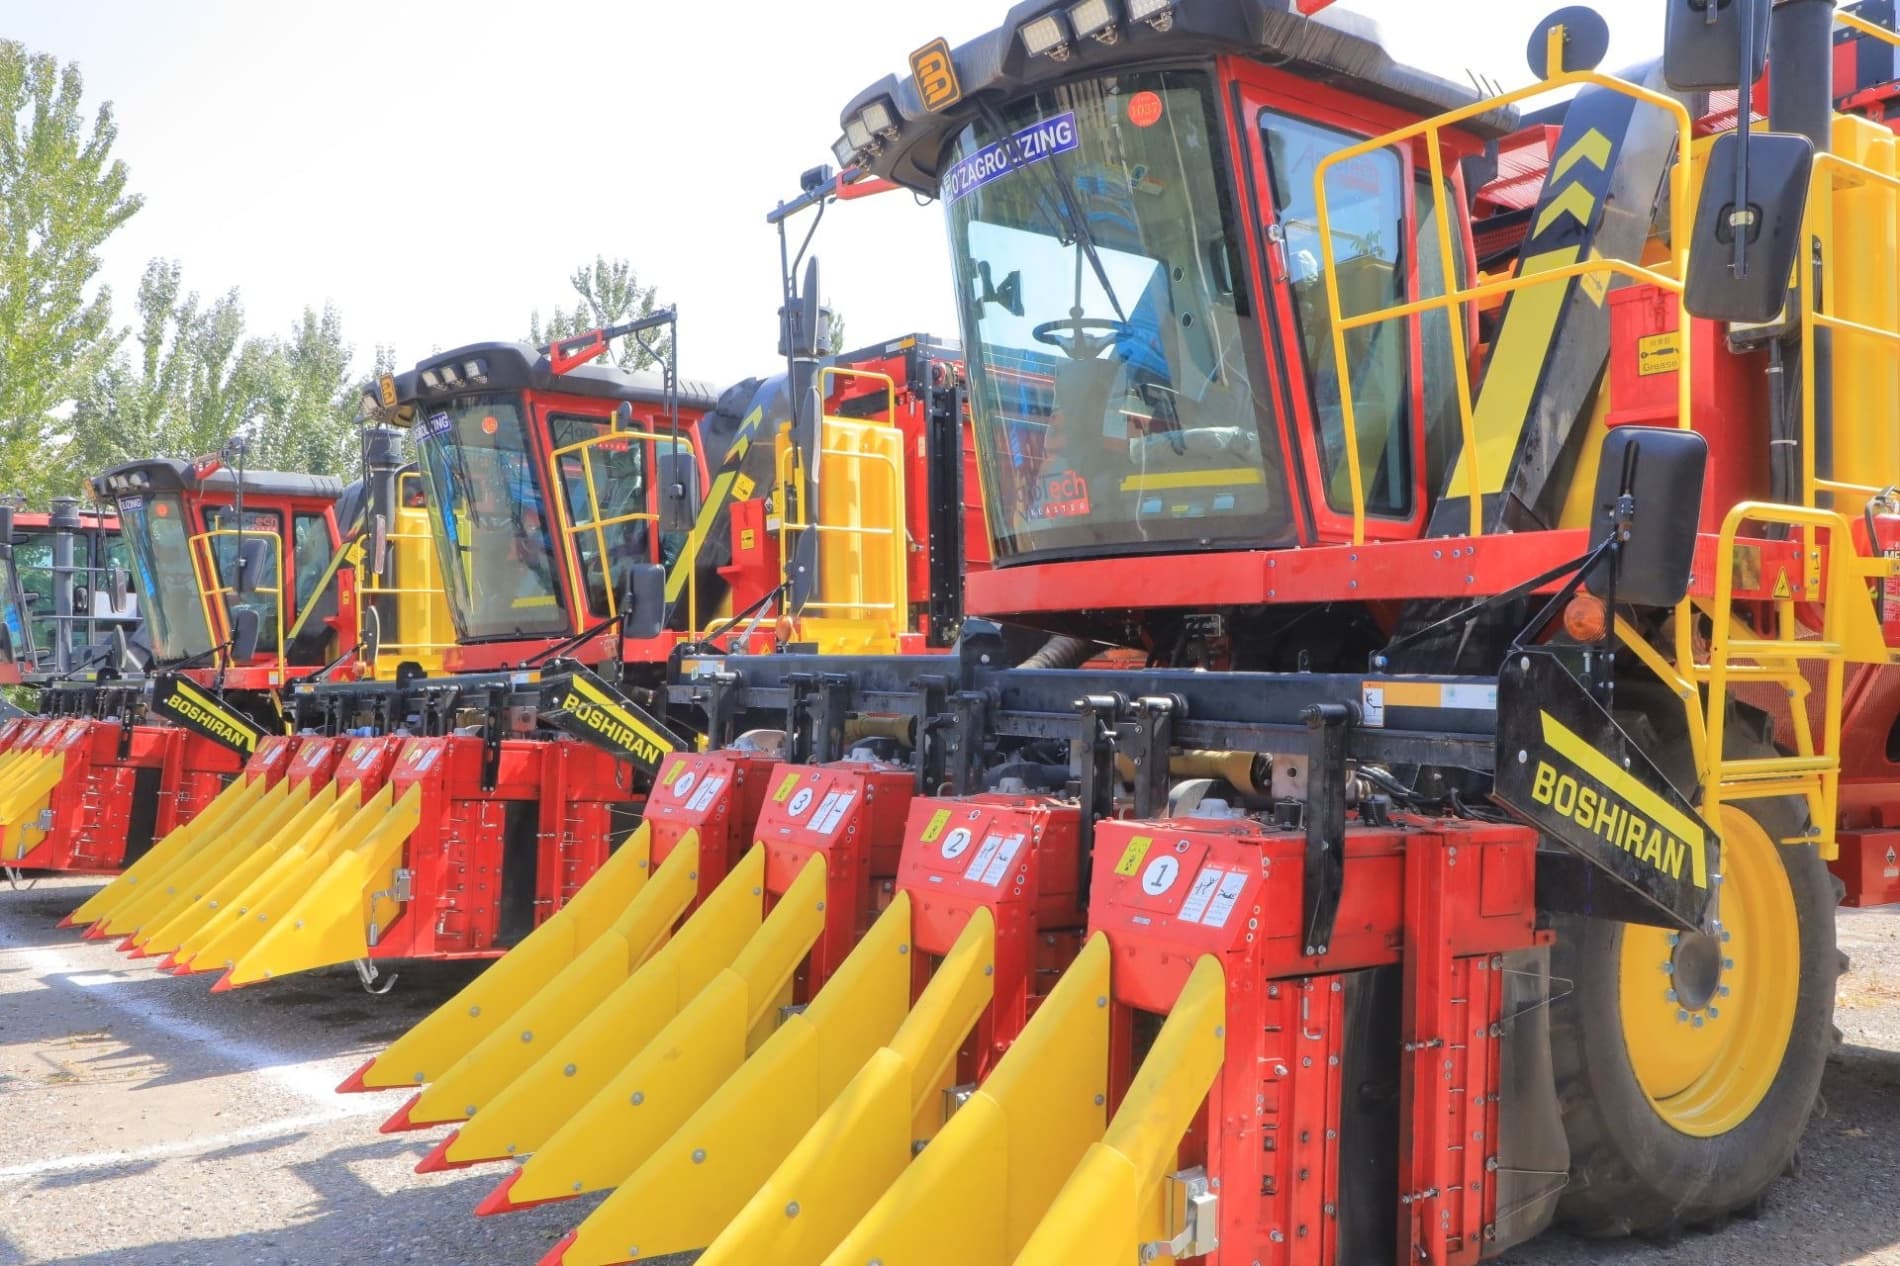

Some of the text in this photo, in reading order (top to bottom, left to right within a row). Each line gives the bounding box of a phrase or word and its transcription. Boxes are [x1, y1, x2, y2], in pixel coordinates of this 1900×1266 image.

[167, 693, 246, 746] BOSHIRAN
[562, 692, 660, 765] BOSHIRAN
[792, 793, 810, 811] 3
[1531, 759, 1686, 880] BOSHIRAN
[947, 832, 965, 853] 2
[1150, 863, 1169, 888] 1
